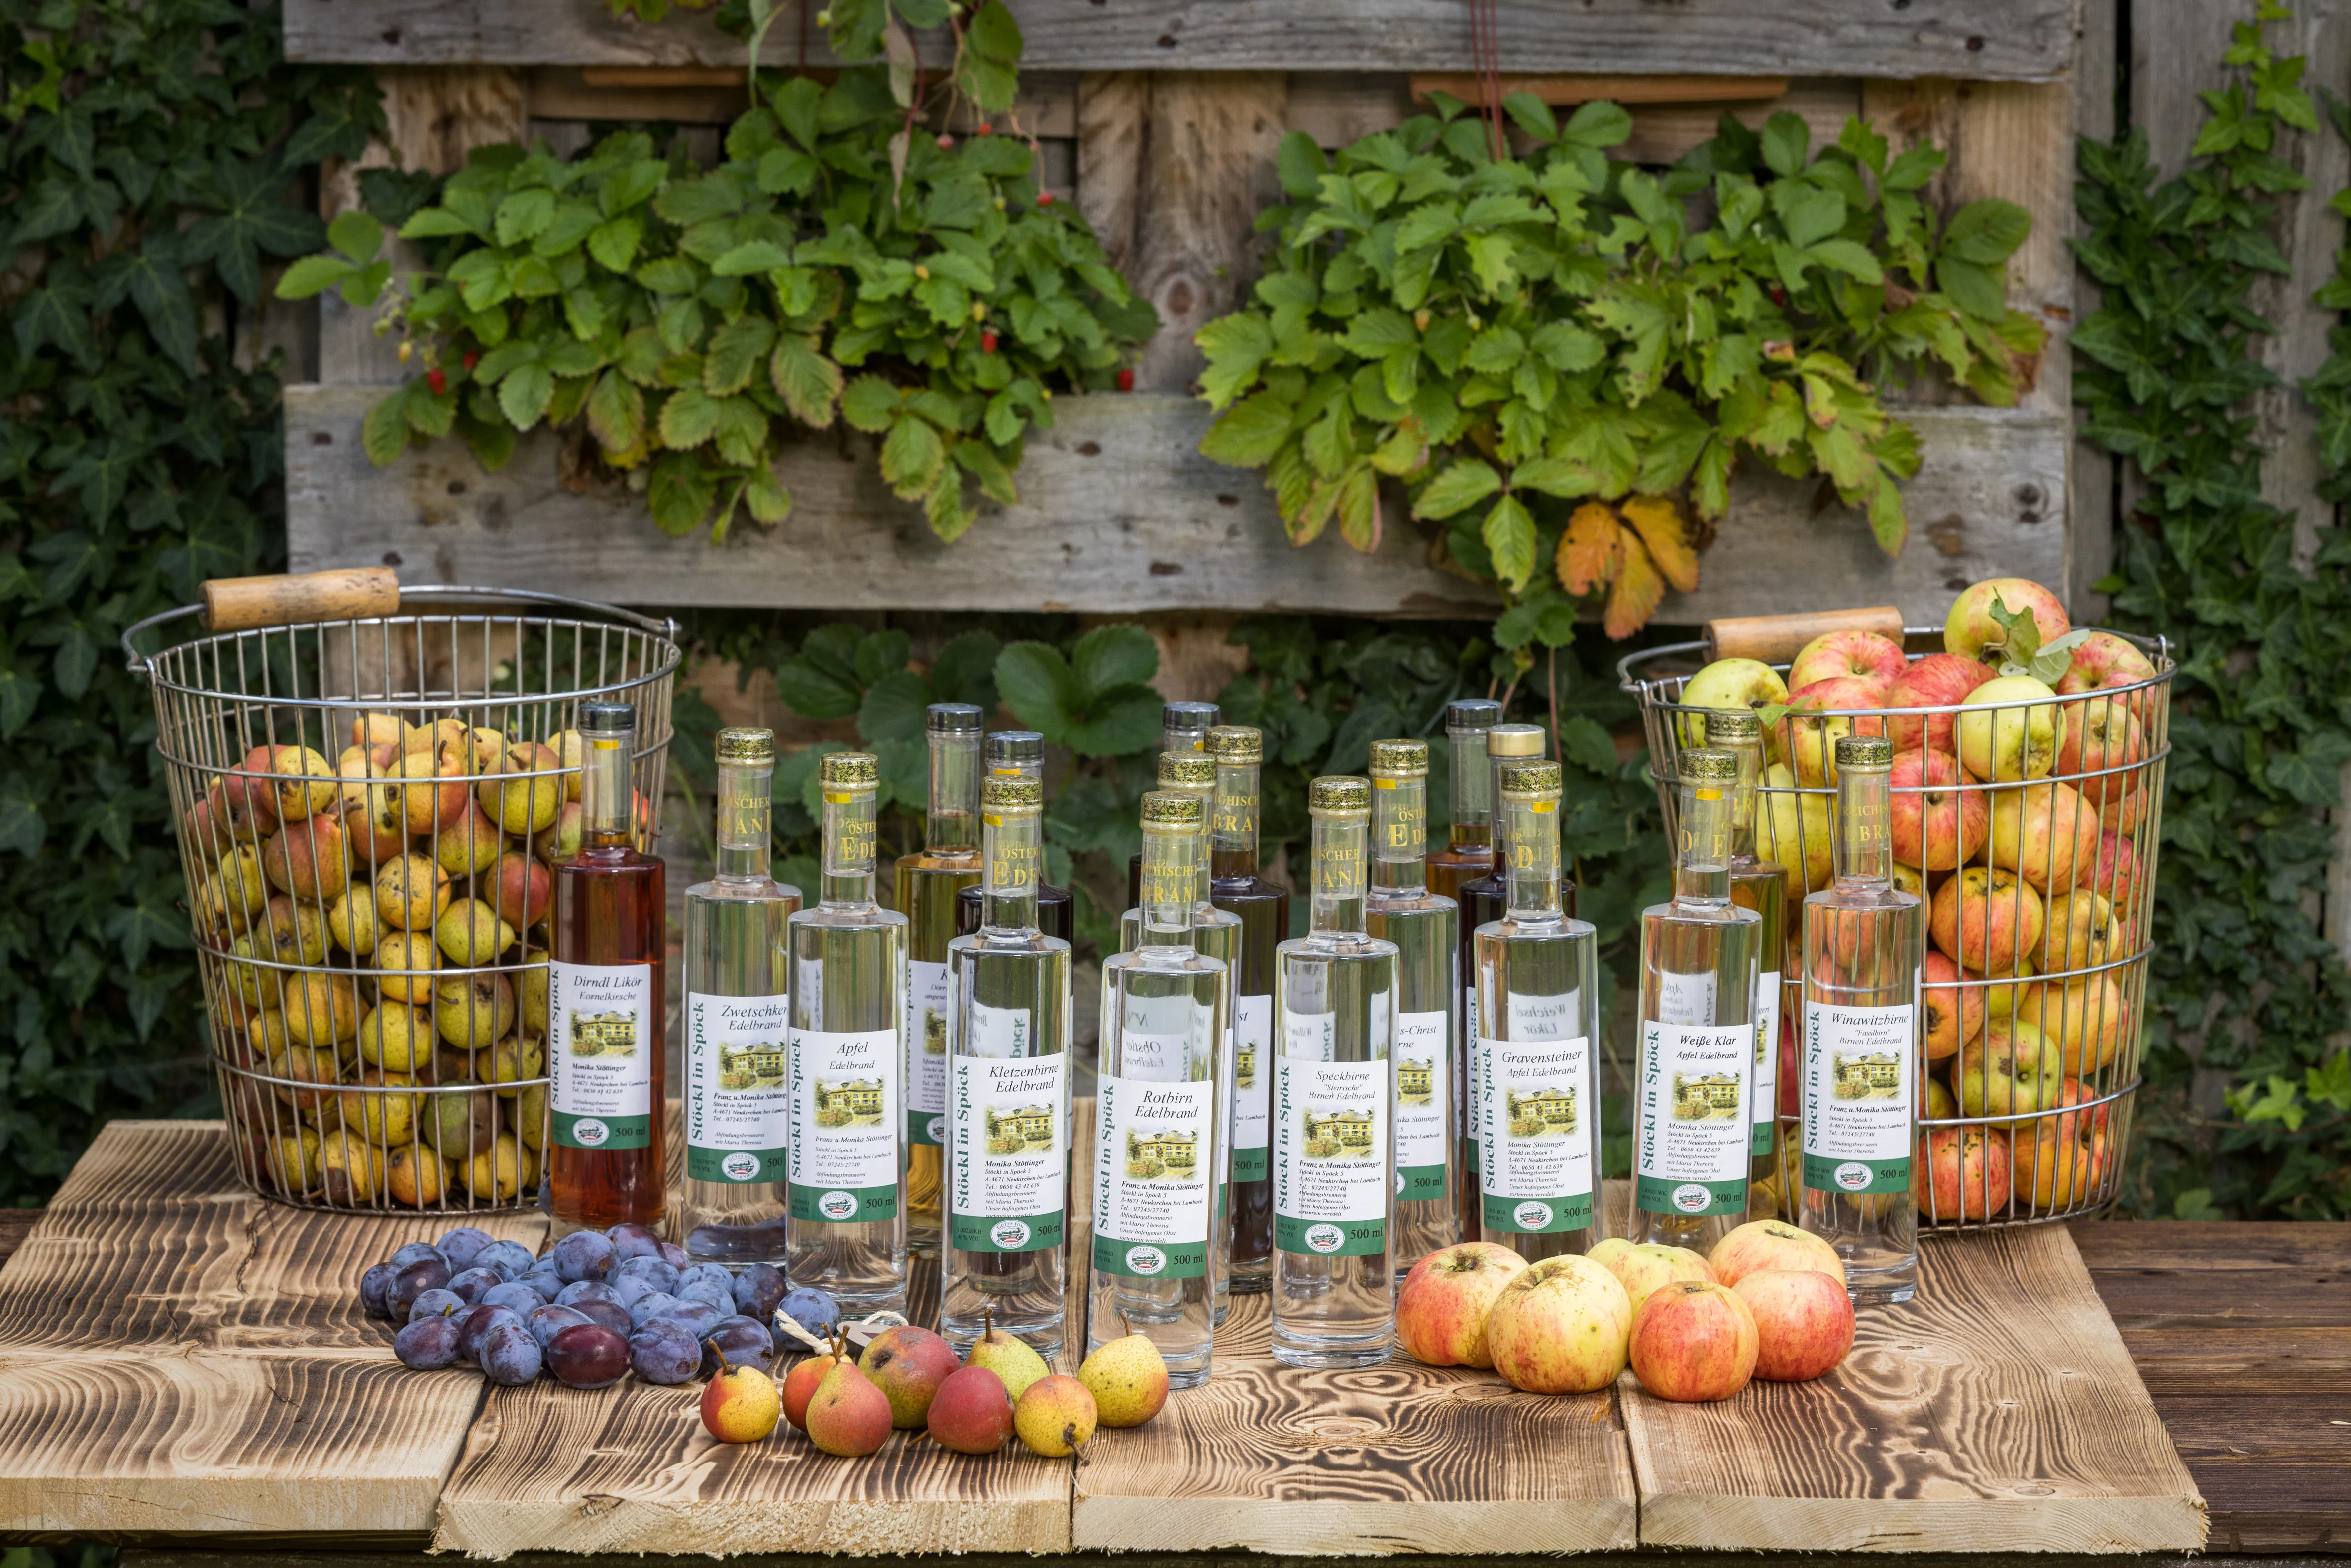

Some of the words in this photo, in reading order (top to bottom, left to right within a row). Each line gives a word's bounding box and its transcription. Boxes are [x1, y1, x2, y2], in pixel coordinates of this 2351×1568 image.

[574, 976, 609, 987] Dirndl
[614, 977, 642, 987] Likör
[552, 970, 561, 1022] Spöck
[580, 992, 636, 1000] Kornelkirsche
[729, 1018, 782, 1030] Edelbrand
[1832, 1013, 1908, 1025] Winawitzbirne
[693, 1002, 707, 1056] Spöck
[552, 1029, 558, 1044] in
[1680, 1035, 1711, 1047] Weiße
[1715, 1036, 1736, 1045] Klar
[1810, 1011, 1822, 1065] Spöck
[1866, 1036, 1902, 1045] Edelbrand
[837, 1042, 868, 1056] Apfel
[1677, 1051, 1697, 1060] Apfel
[1700, 1051, 1738, 1059] Edelbrand
[1502, 1051, 1582, 1063] Gravensteiner
[1646, 1030, 1661, 1085] Spöck
[693, 1062, 703, 1079] in
[792, 1038, 803, 1092] Spöck
[830, 1060, 875, 1069] Edelbrand
[989, 1064, 1058, 1077] Kletzenbirne
[1507, 1068, 1529, 1078] Apfel
[1533, 1065, 1577, 1076] Edelbrand
[1316, 1071, 1370, 1082] Speckbirne
[1483, 1047, 1495, 1102] Spöck
[1809, 1071, 1818, 1088] in
[996, 1077, 1055, 1092] Edelbrand
[958, 1065, 971, 1121] Spöck
[1143, 1091, 1193, 1104] Rotbirn
[1280, 1065, 1292, 1122] Spöck
[1337, 1091, 1375, 1101] Edelbrand
[1645, 1091, 1656, 1109] in
[692, 1085, 703, 1140] Stöckl
[792, 1099, 801, 1116] in
[1102, 1084, 1115, 1142] Spöck
[1135, 1106, 1199, 1119] Edelbrand
[1485, 1109, 1493, 1126] in
[1808, 1093, 1818, 1149] Stöckl
[616, 1127, 633, 1137] 500
[636, 1126, 645, 1135] ml
[958, 1128, 968, 1145] in
[1280, 1128, 1288, 1146] in
[1643, 1113, 1655, 1170] Stöckl
[792, 1122, 801, 1178] Stöckl
[1101, 1148, 1111, 1166] in
[767, 1159, 782, 1167] 500
[1235, 1160, 1251, 1170] 500
[1254, 1159, 1264, 1168] ml
[1485, 1132, 1495, 1188] Stöckl
[957, 1150, 969, 1208] Stöckl
[1045, 1170, 1061, 1179] Lambach
[1279, 1151, 1288, 1209] Stöckl
[1880, 1169, 1896, 1179] 500
[1899, 1167, 1907, 1177] ml
[1121, 1181, 1140, 1189] Franz
[1414, 1177, 1430, 1187] 500
[1432, 1176, 1442, 1186] ml
[866, 1199, 883, 1208] 500
[886, 1196, 895, 1206] ml
[1099, 1170, 1110, 1230] Stöckl
[1715, 1193, 1731, 1203] 500
[1734, 1192, 1742, 1201] ml
[1120, 1212, 1172, 1221] Abfindungsbrennerei
[1564, 1208, 1580, 1218] 500
[1583, 1204, 1591, 1215] ml
[1037, 1224, 1052, 1236] 500
[1054, 1222, 1061, 1232] ml
[1350, 1229, 1369, 1239] 500
[1373, 1227, 1383, 1238] ml
[996, 1239, 1025, 1247] BAUERNHOF
[1174, 1254, 1190, 1265] 500
[1193, 1253, 1203, 1263] ml
